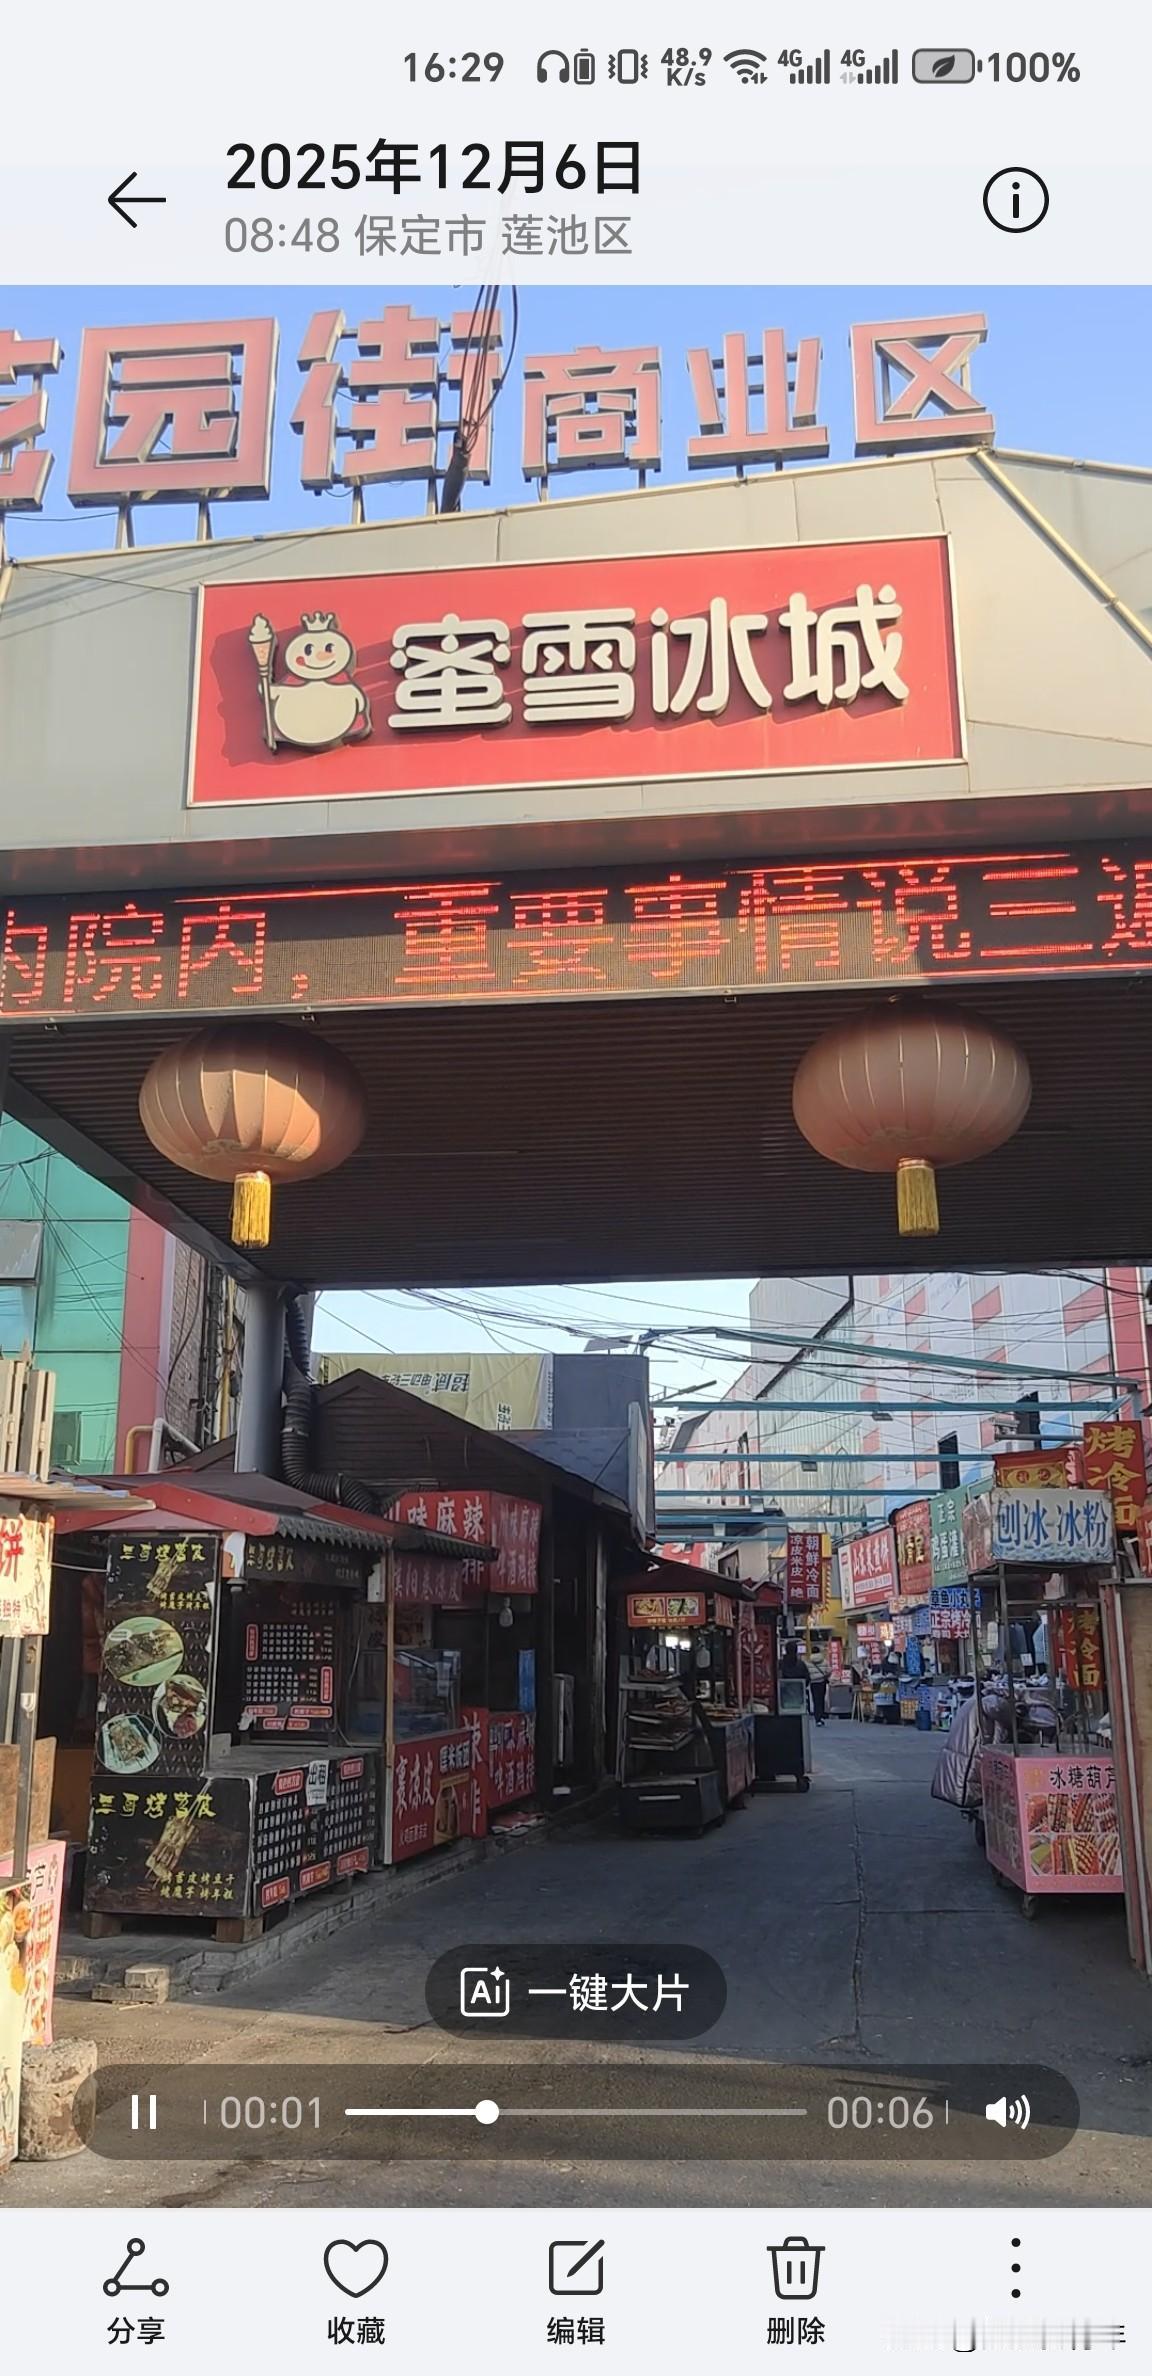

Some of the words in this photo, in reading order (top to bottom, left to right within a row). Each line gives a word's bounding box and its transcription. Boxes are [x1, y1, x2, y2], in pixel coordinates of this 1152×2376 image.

[388, 584, 909, 728] 蜜雪冰城
[931, 1529, 965, 1562] 鸡蛋灌
[1056, 1499, 1108, 1549] 冰粉
[806, 1535, 820, 1599] 朝鲜冷面
